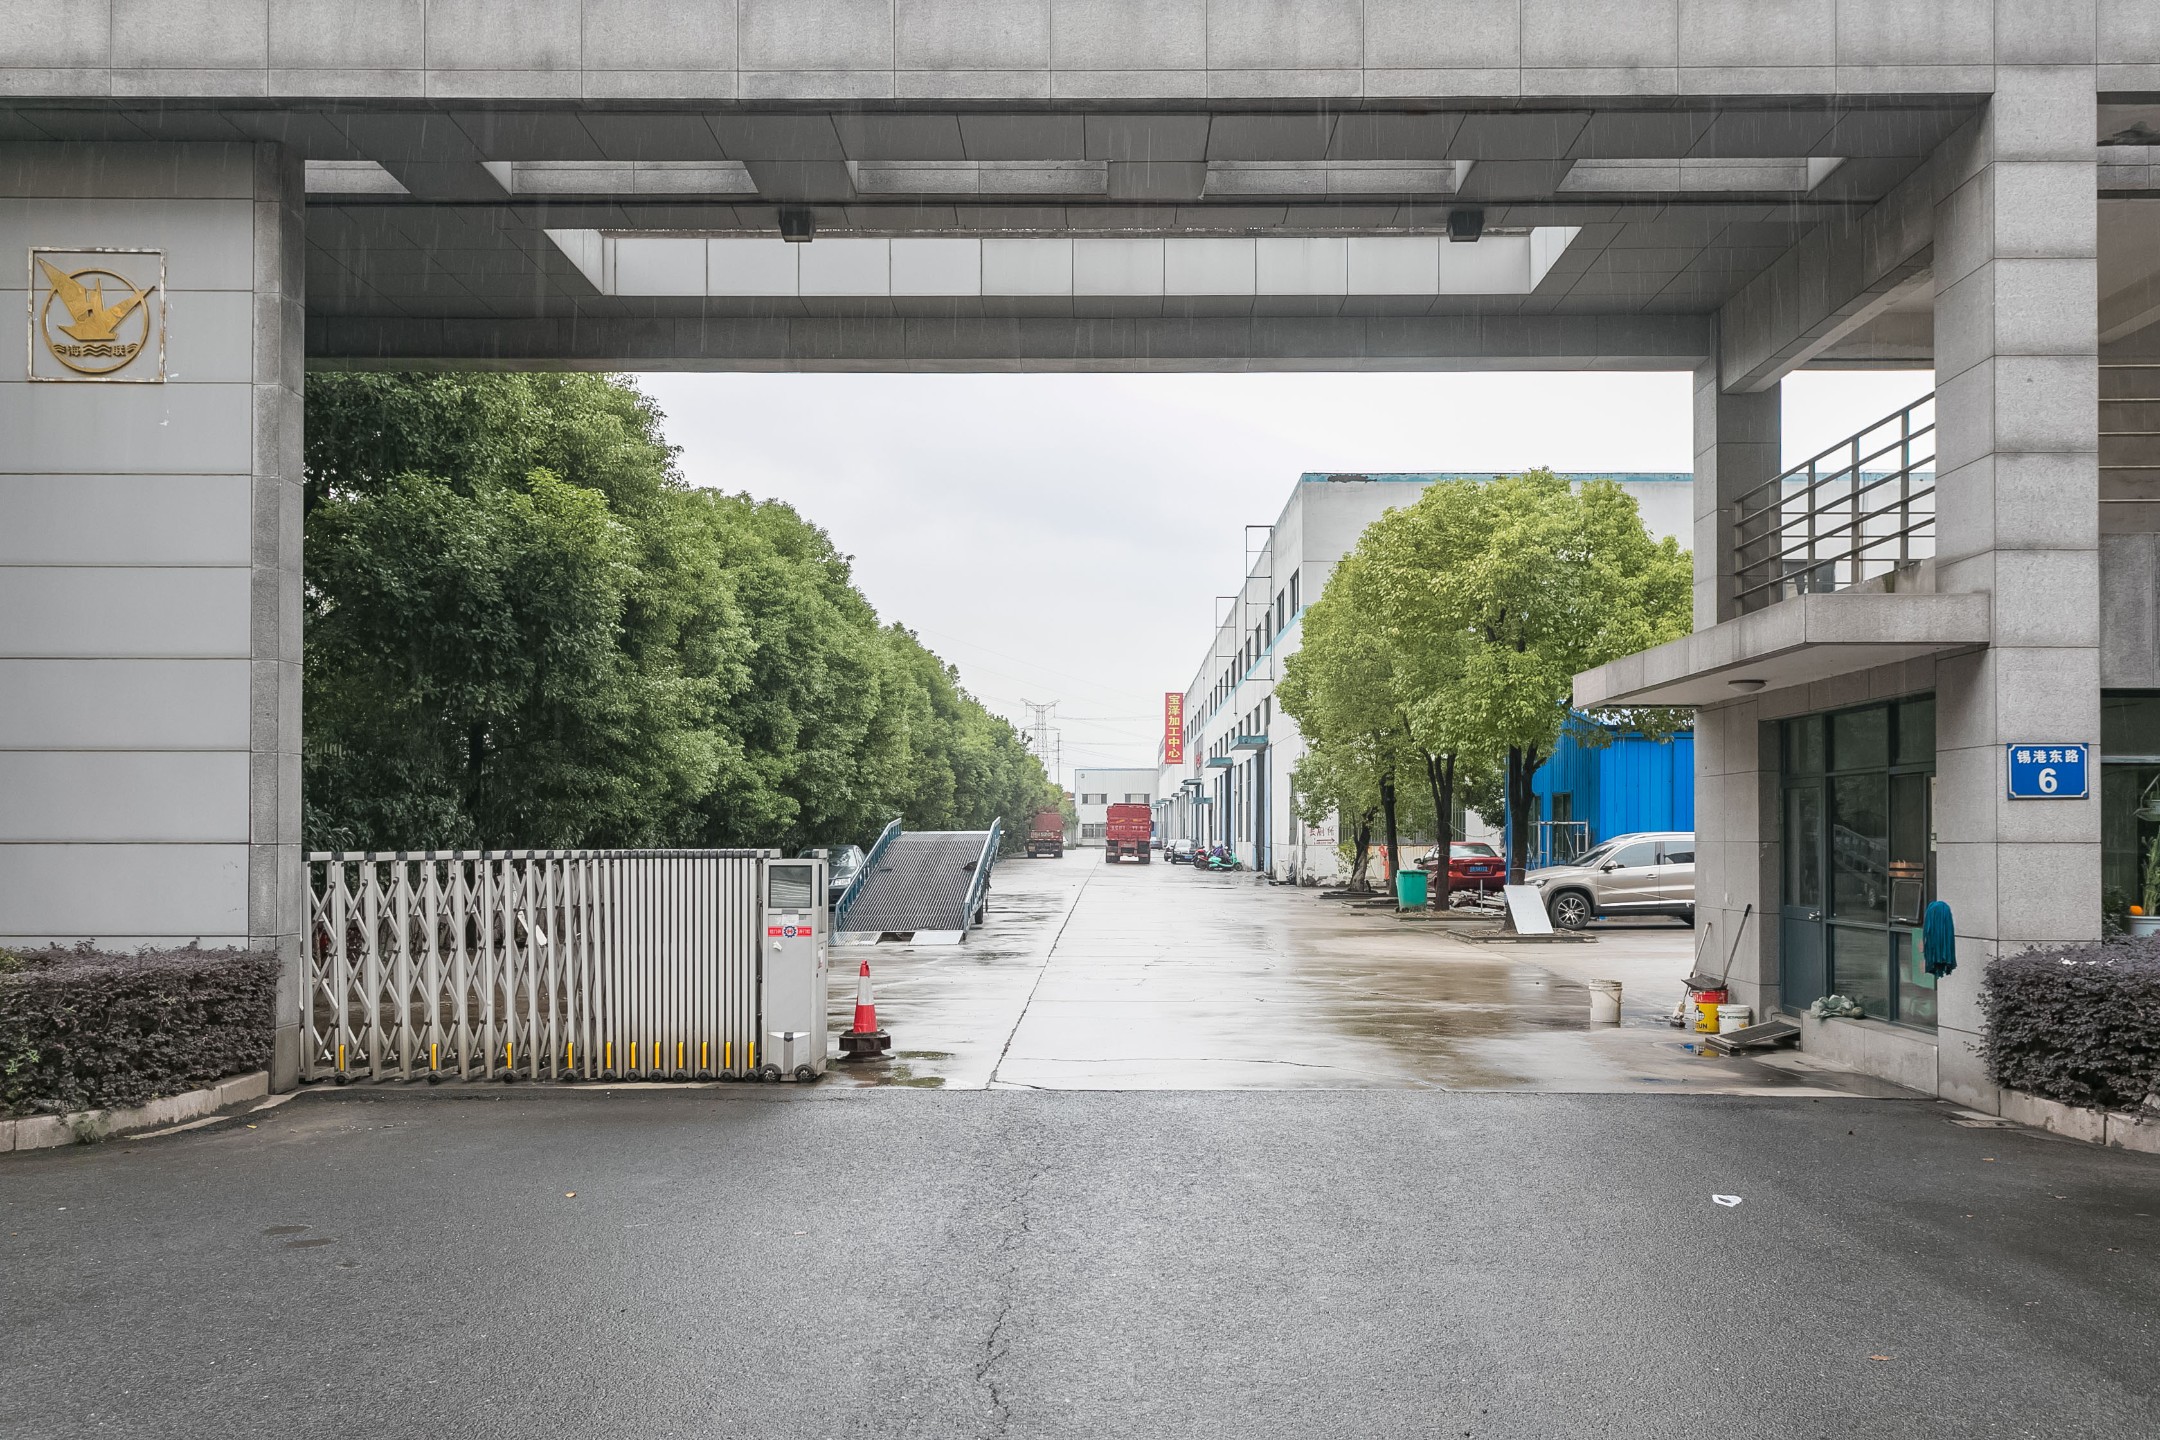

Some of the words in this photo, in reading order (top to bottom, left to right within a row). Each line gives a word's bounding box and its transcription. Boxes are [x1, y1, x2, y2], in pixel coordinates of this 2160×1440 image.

[1168, 694, 1181, 758] 宝泽加工中心
[2016, 749, 2079, 764] 锡港东路
[2039, 768, 2057, 793] 6
